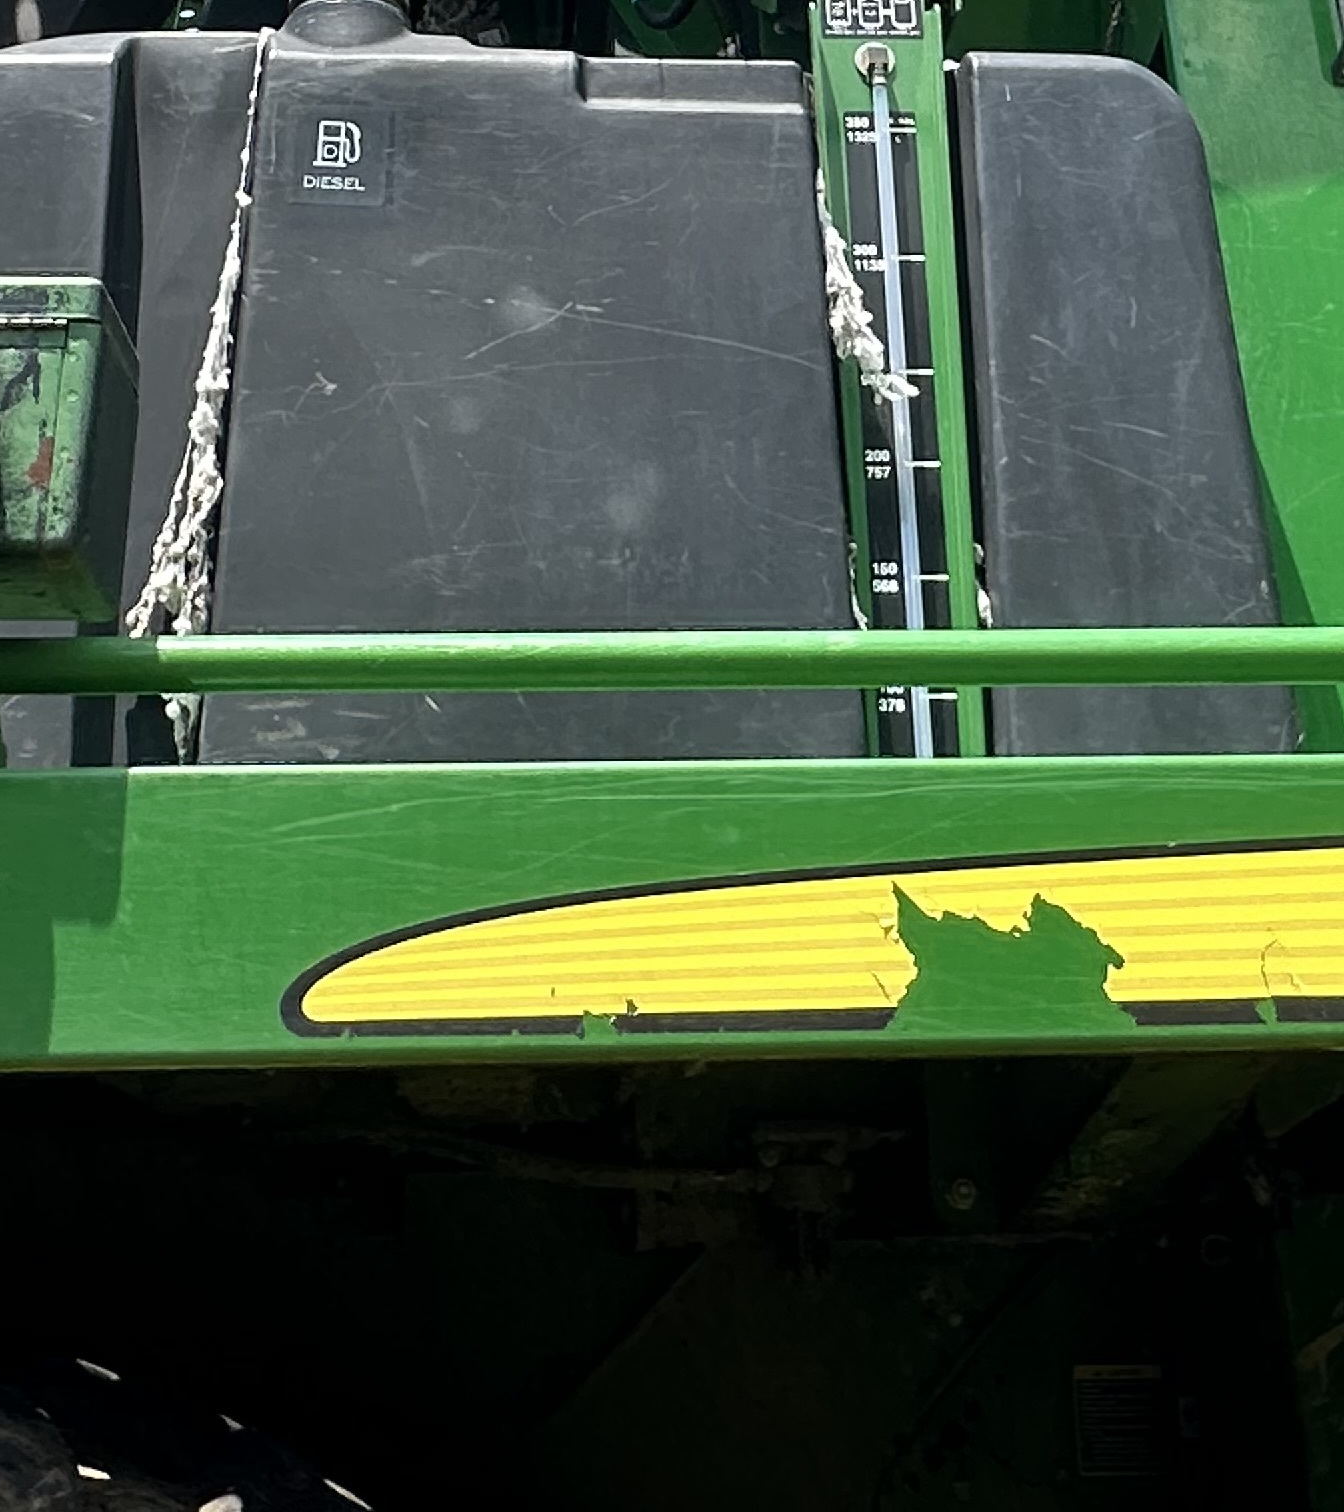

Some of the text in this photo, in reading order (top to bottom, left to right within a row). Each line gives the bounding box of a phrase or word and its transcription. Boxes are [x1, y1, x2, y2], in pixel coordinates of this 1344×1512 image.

[302, 174, 366, 192] DIESEL
[864, 448, 890, 462] 200
[864, 465, 892, 479] 757
[872, 562, 898, 576] 150
